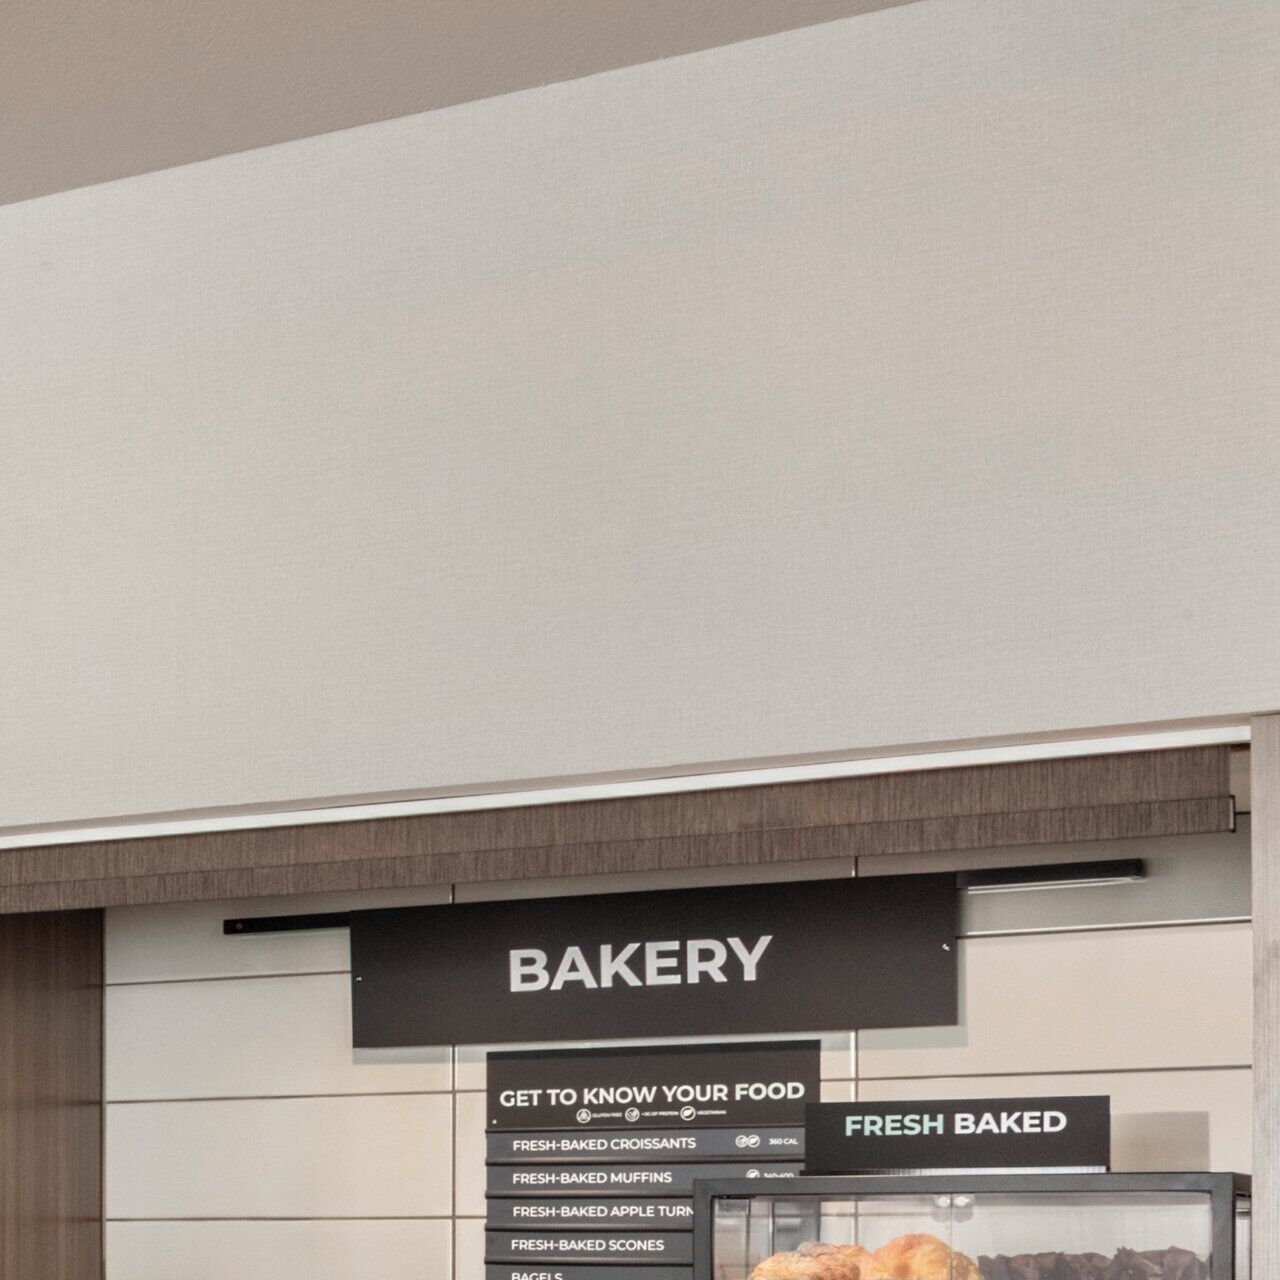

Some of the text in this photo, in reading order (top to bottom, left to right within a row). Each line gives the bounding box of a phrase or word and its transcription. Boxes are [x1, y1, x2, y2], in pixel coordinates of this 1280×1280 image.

[510, 936, 772, 992] BAKERY
[500, 1082, 804, 1106] GET TO KNOW YOUR FOOD
[846, 1111, 1066, 1136] FRESH BAKED
[513, 1139, 608, 1151] FRESH-BAKED
[611, 1138, 696, 1150] CROISSANTS
[513, 1173, 607, 1184] FRESH-BAKED
[611, 1172, 672, 1183] MUFFINS
[513, 1206, 608, 1217] FRESH-BAKED
[610, 1206, 654, 1216] APPLE
[512, 1240, 664, 1250] FRESH-BAKED SCONES
